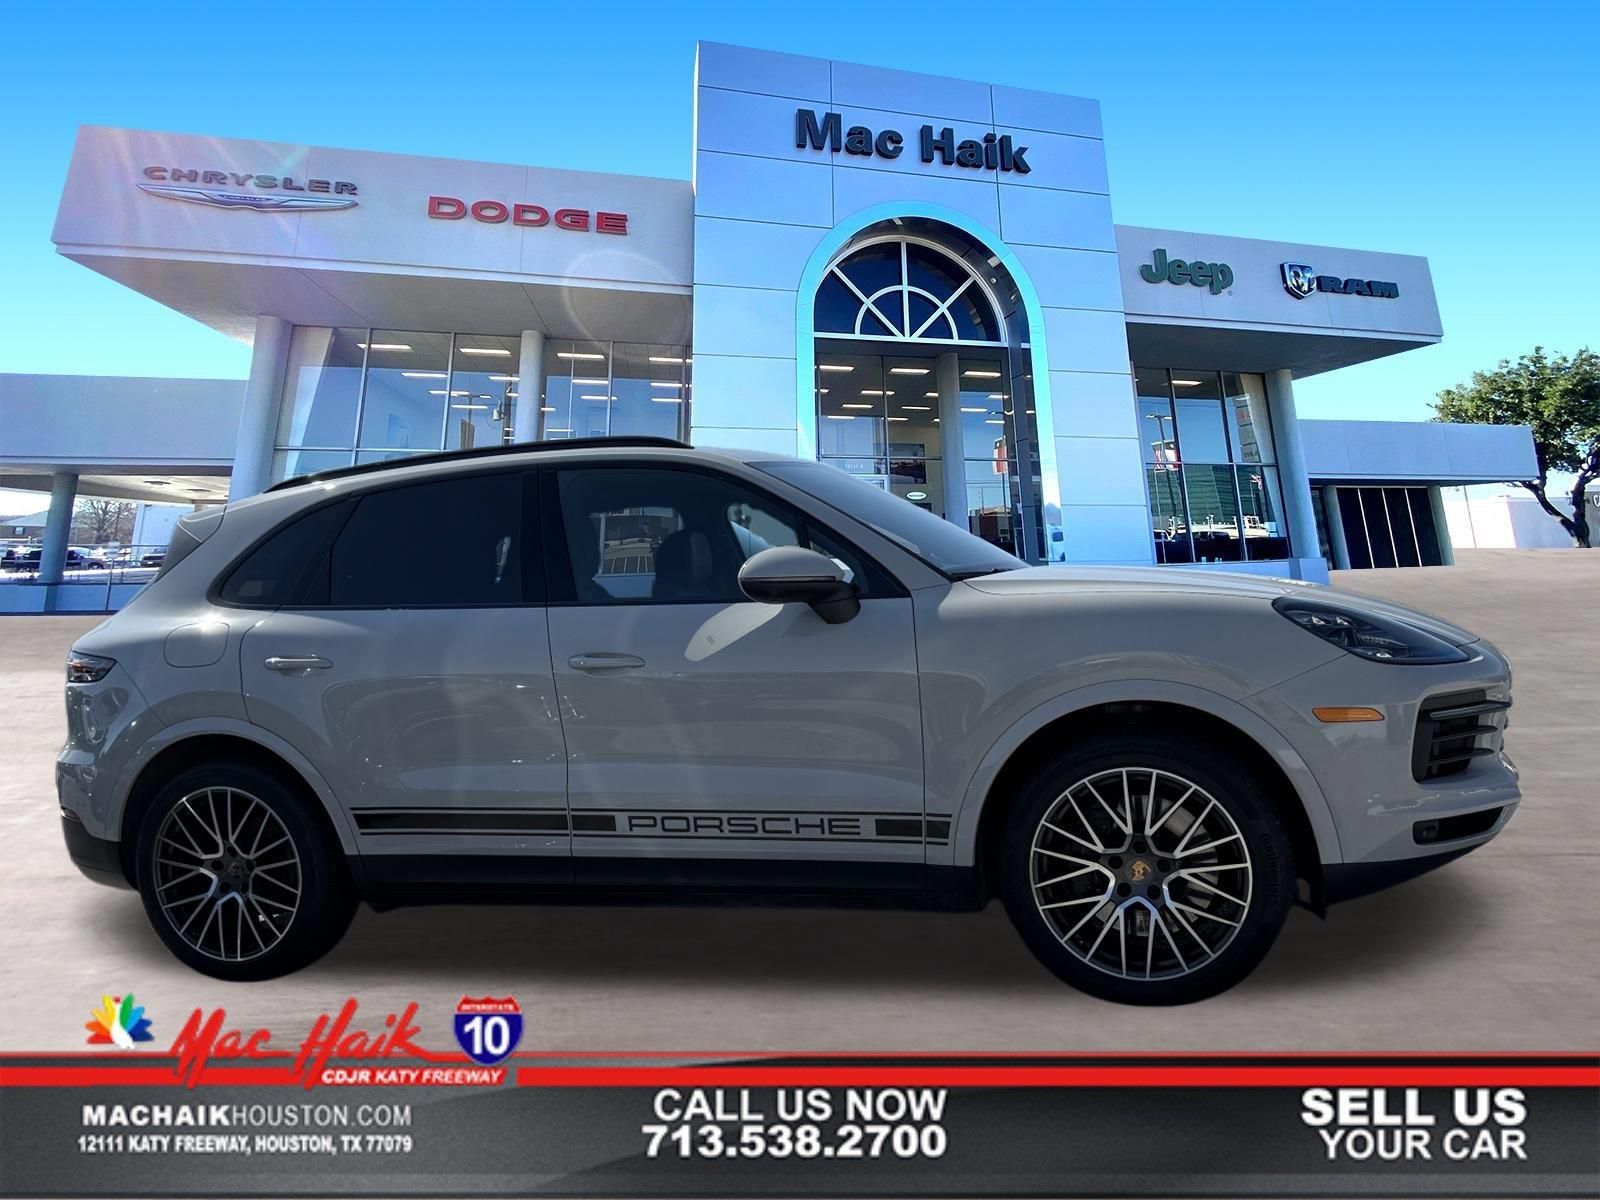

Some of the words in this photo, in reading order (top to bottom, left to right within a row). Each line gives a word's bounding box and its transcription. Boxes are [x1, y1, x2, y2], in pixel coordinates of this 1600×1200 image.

[795, 108, 904, 159] Mac
[920, 124, 1032, 174] Haik
[143, 166, 359, 195] CHRYSLER
[428, 195, 628, 236] DODGE
[1140, 248, 1234, 296] Jeep
[1316, 275, 1399, 299] RAM
[628, 815, 862, 836] PORSCHE
